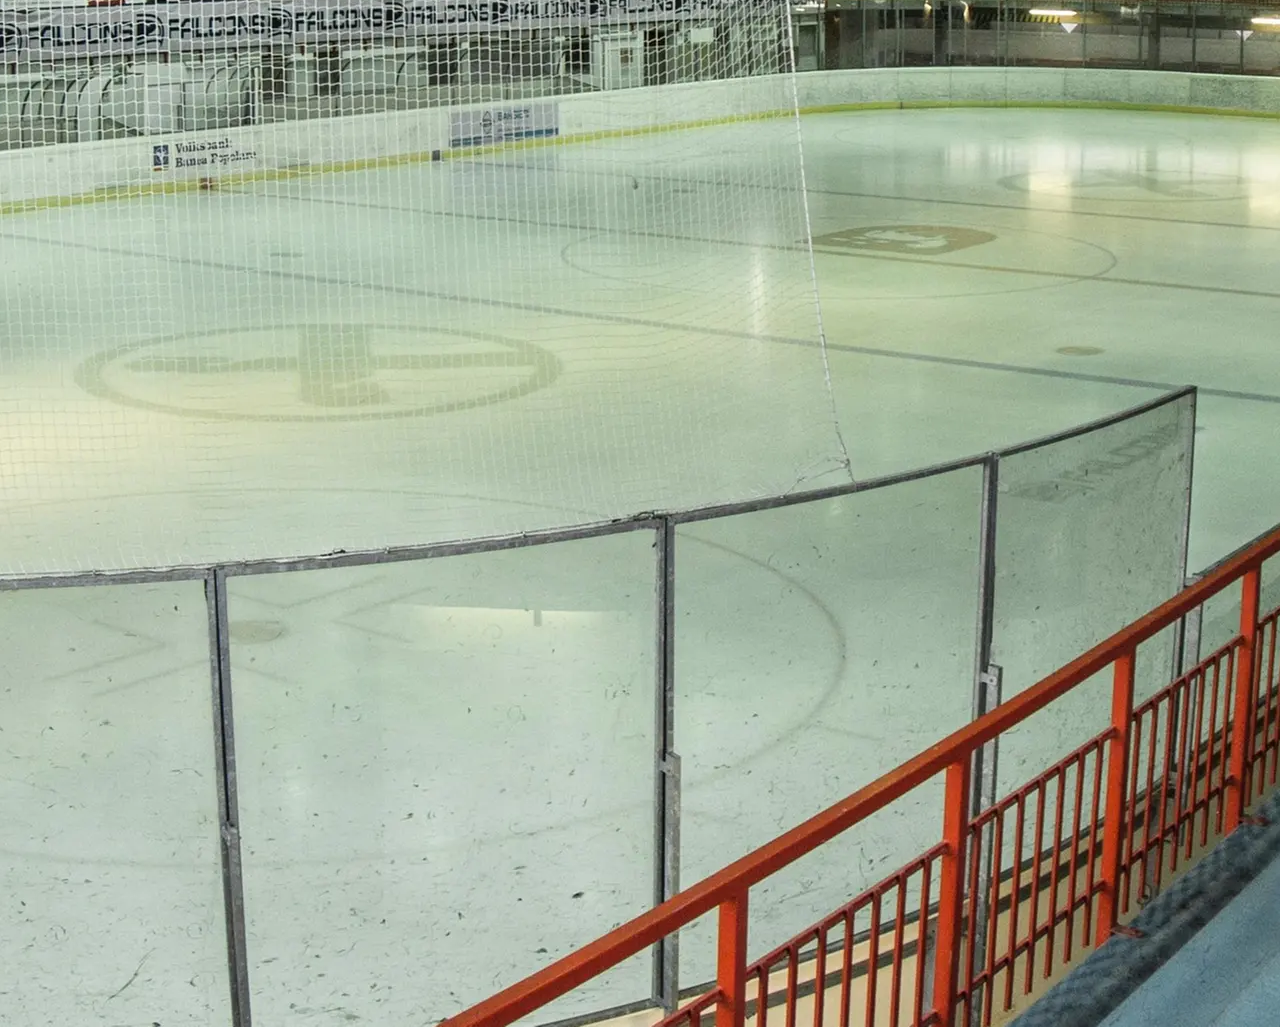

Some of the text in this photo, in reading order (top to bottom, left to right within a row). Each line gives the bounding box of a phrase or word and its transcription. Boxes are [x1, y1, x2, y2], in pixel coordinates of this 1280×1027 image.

[27, 21, 134, 47] FALCONS
[169, 15, 265, 40] FALCONS
[295, 8, 383, 32] FALCONS
[410, 3, 488, 26] FALCONS
[515, 0, 586, 20] FALCONS
[175, 156, 207, 168] Banca
